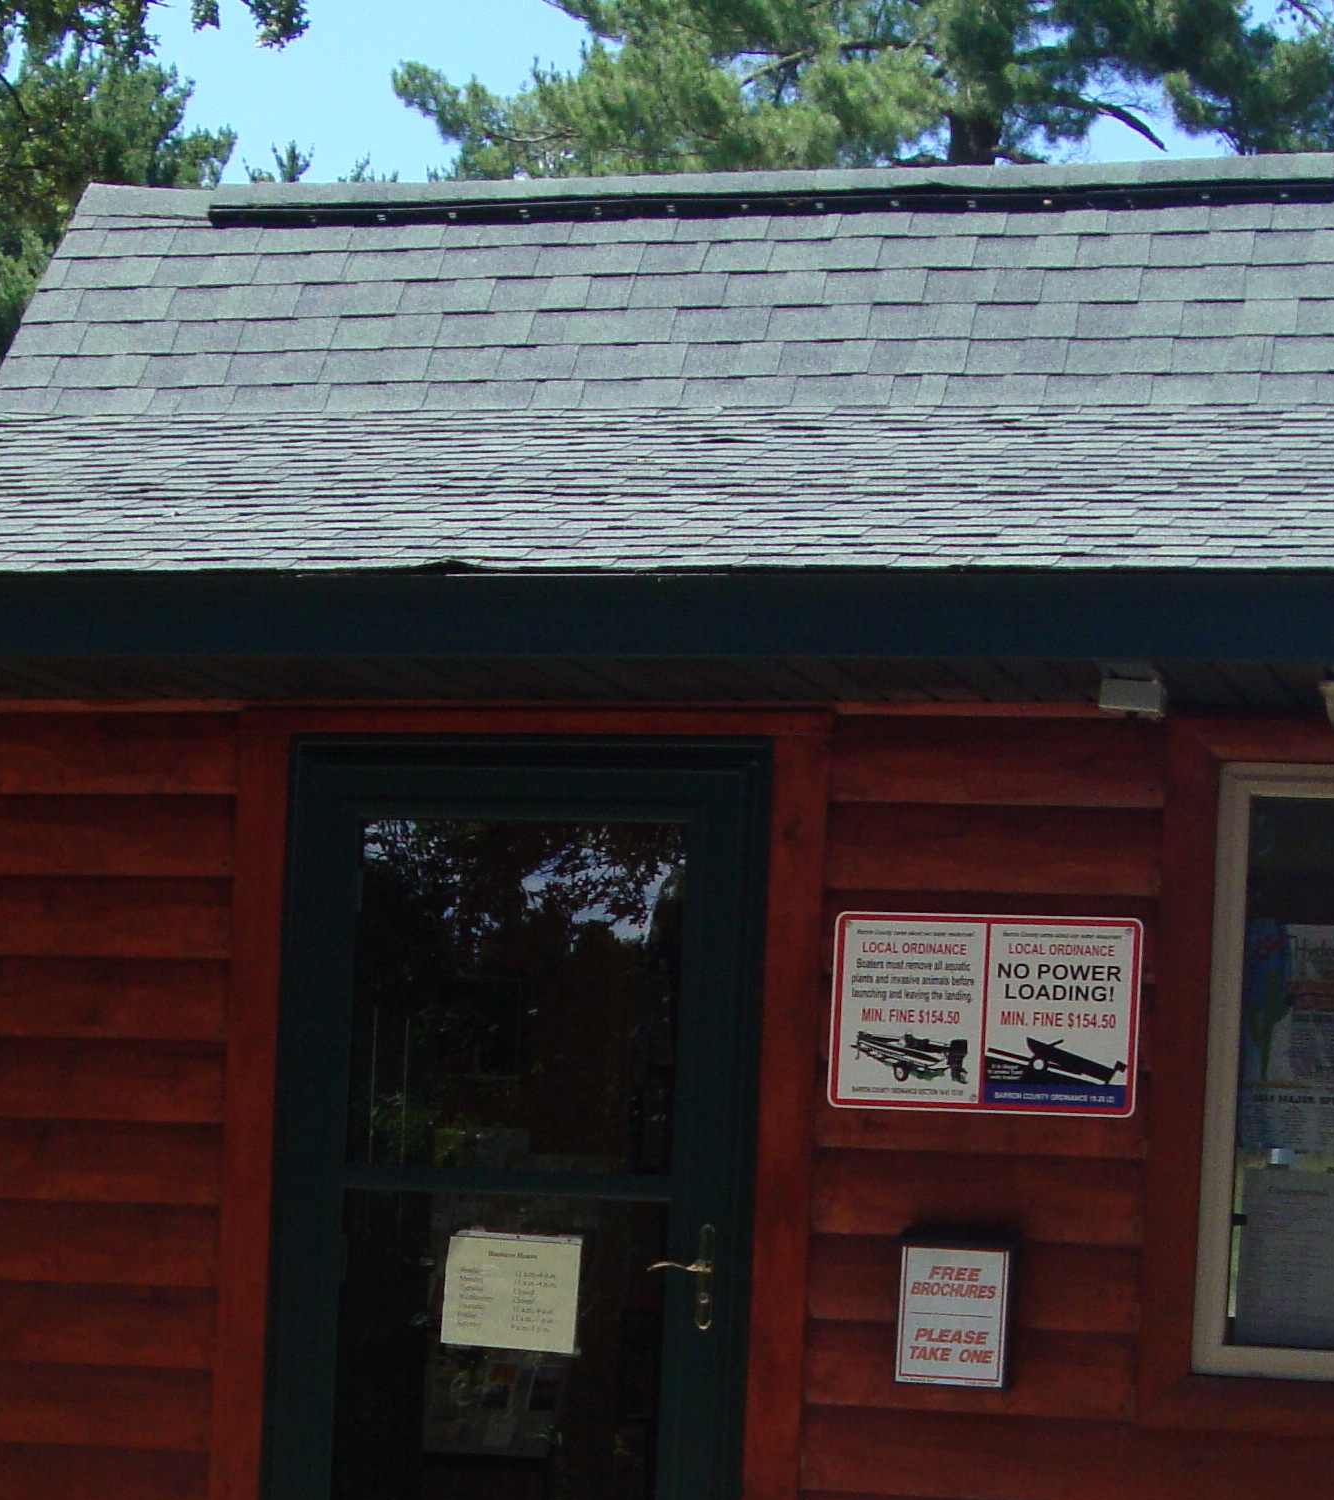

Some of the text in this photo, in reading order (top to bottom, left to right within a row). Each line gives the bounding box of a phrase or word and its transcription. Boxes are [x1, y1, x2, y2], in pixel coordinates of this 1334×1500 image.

[862, 942, 967, 955] LOCAL ORDINANCE
[1008, 943, 1115, 957] LOCAL ORDINANCE
[856, 958, 971, 972] Boaters must remove all aquatic
[997, 963, 1121, 982] NO POWER
[851, 974, 974, 986] plants and invasive animals before
[851, 988, 887, 1001] launching
[888, 989, 902, 999] and
[904, 989, 930, 1002] leaving
[931, 990, 942, 1000] the
[1004, 984, 1114, 1002] LOADING!
[861, 1008, 960, 1024] MIN. FINE $154.50
[1000, 1011, 1117, 1029] MIN. FINE $154.50
[994, 1091, 1022, 1099] BARRON
[1022, 1092, 1049, 1100] COUNTY
[928, 1266, 982, 1282] FREE
[910, 1281, 996, 1300] BROCHURES
[915, 1328, 990, 1345] PLEASE
[909, 1346, 995, 1364] TAKE ONE
